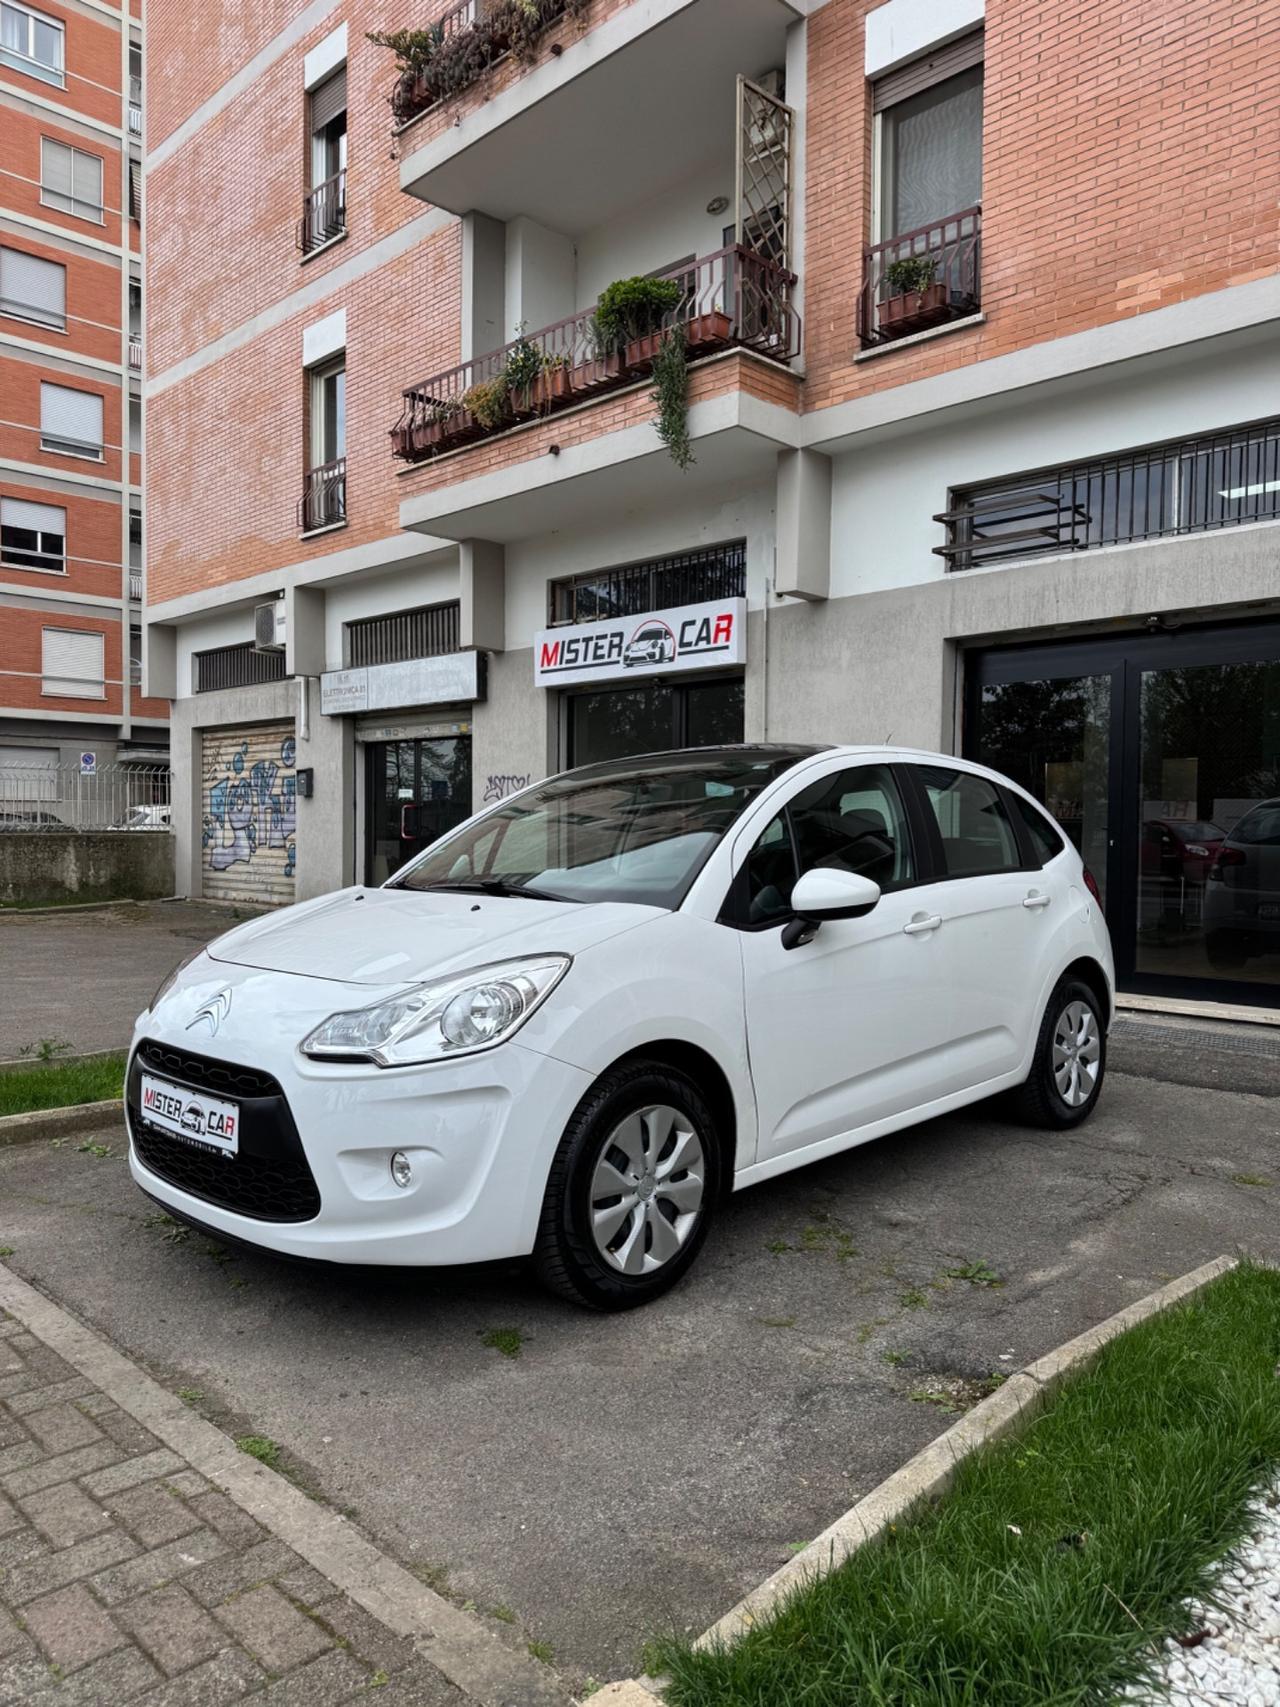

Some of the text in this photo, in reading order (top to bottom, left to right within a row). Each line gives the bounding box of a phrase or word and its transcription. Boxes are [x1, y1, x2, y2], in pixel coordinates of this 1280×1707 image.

[540, 613, 734, 668] MISTER CAR
[144, 1087, 182, 1118] MISTER
[207, 1111, 235, 1136] CAR
